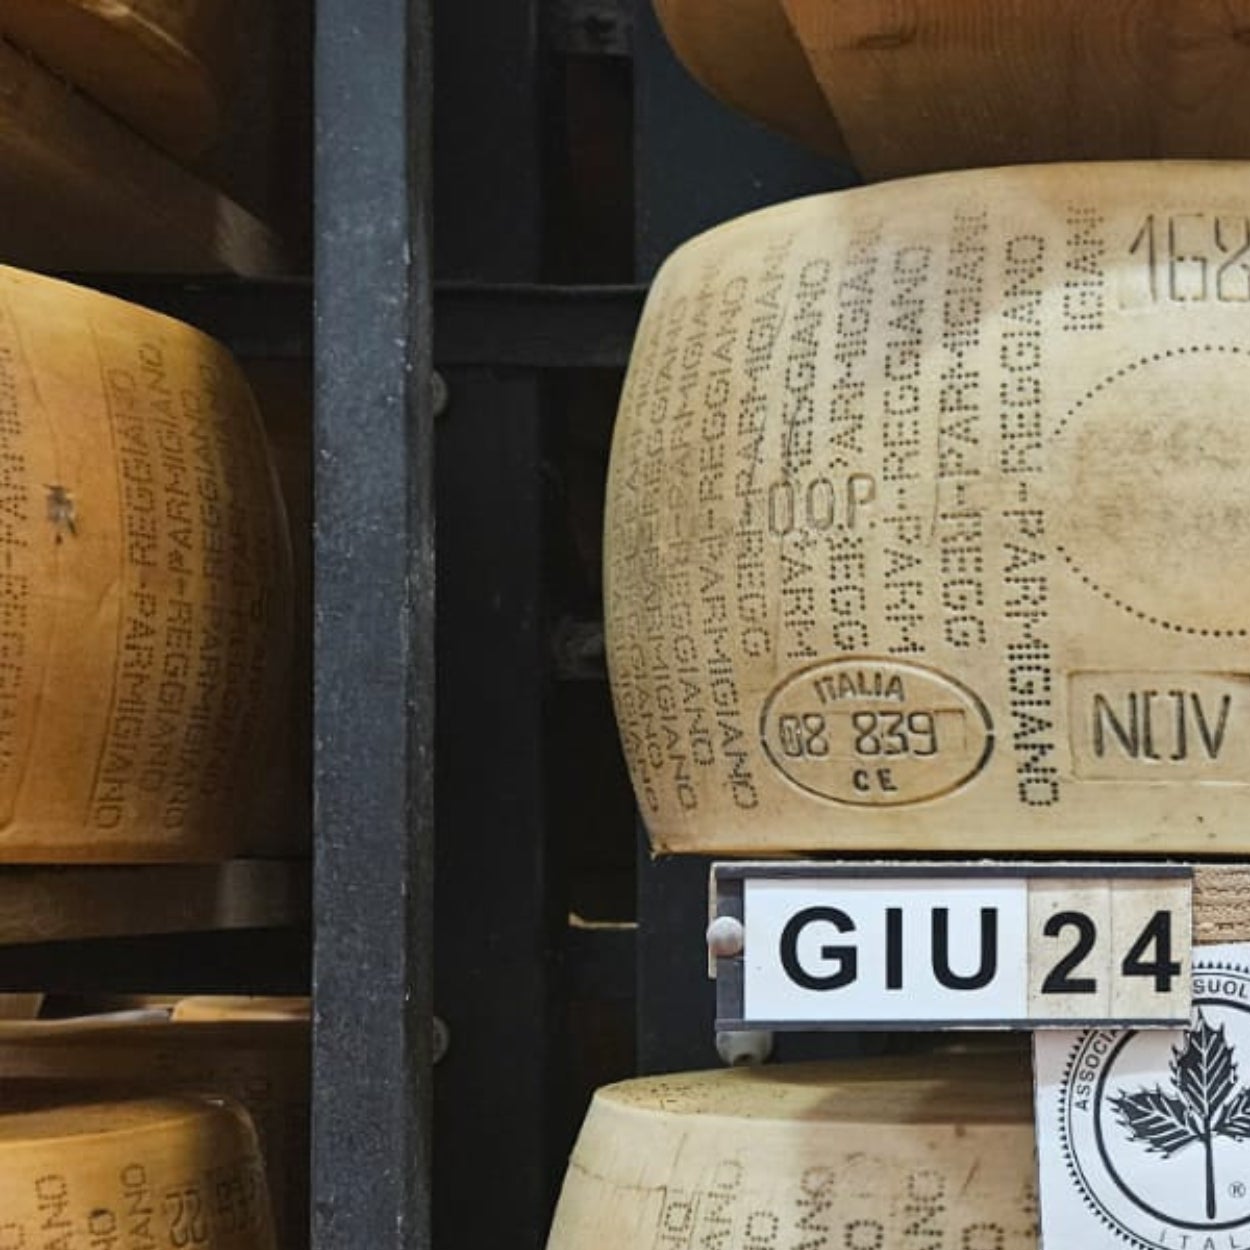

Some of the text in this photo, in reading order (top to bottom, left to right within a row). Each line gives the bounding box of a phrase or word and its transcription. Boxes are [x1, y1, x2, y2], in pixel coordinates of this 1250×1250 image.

[700, 276, 748, 501] REGGIANO
[883, 246, 931, 480] REGGIANO
[1000, 235, 1044, 471] REGGIANO
[700, 533, 759, 810] PARMIGIANO
[941, 511, 987, 647] REGG
[1002, 510, 1060, 805] PARMIGIANO
[97, 590, 157, 829] PARMIGIANO
[141, 601, 193, 793] REGGIANO
[813, 670, 906, 706] ITALIA
[852, 710, 938, 756] 839
[1093, 690, 1232, 761] NOV
[778, 905, 1183, 995] GIU 24
